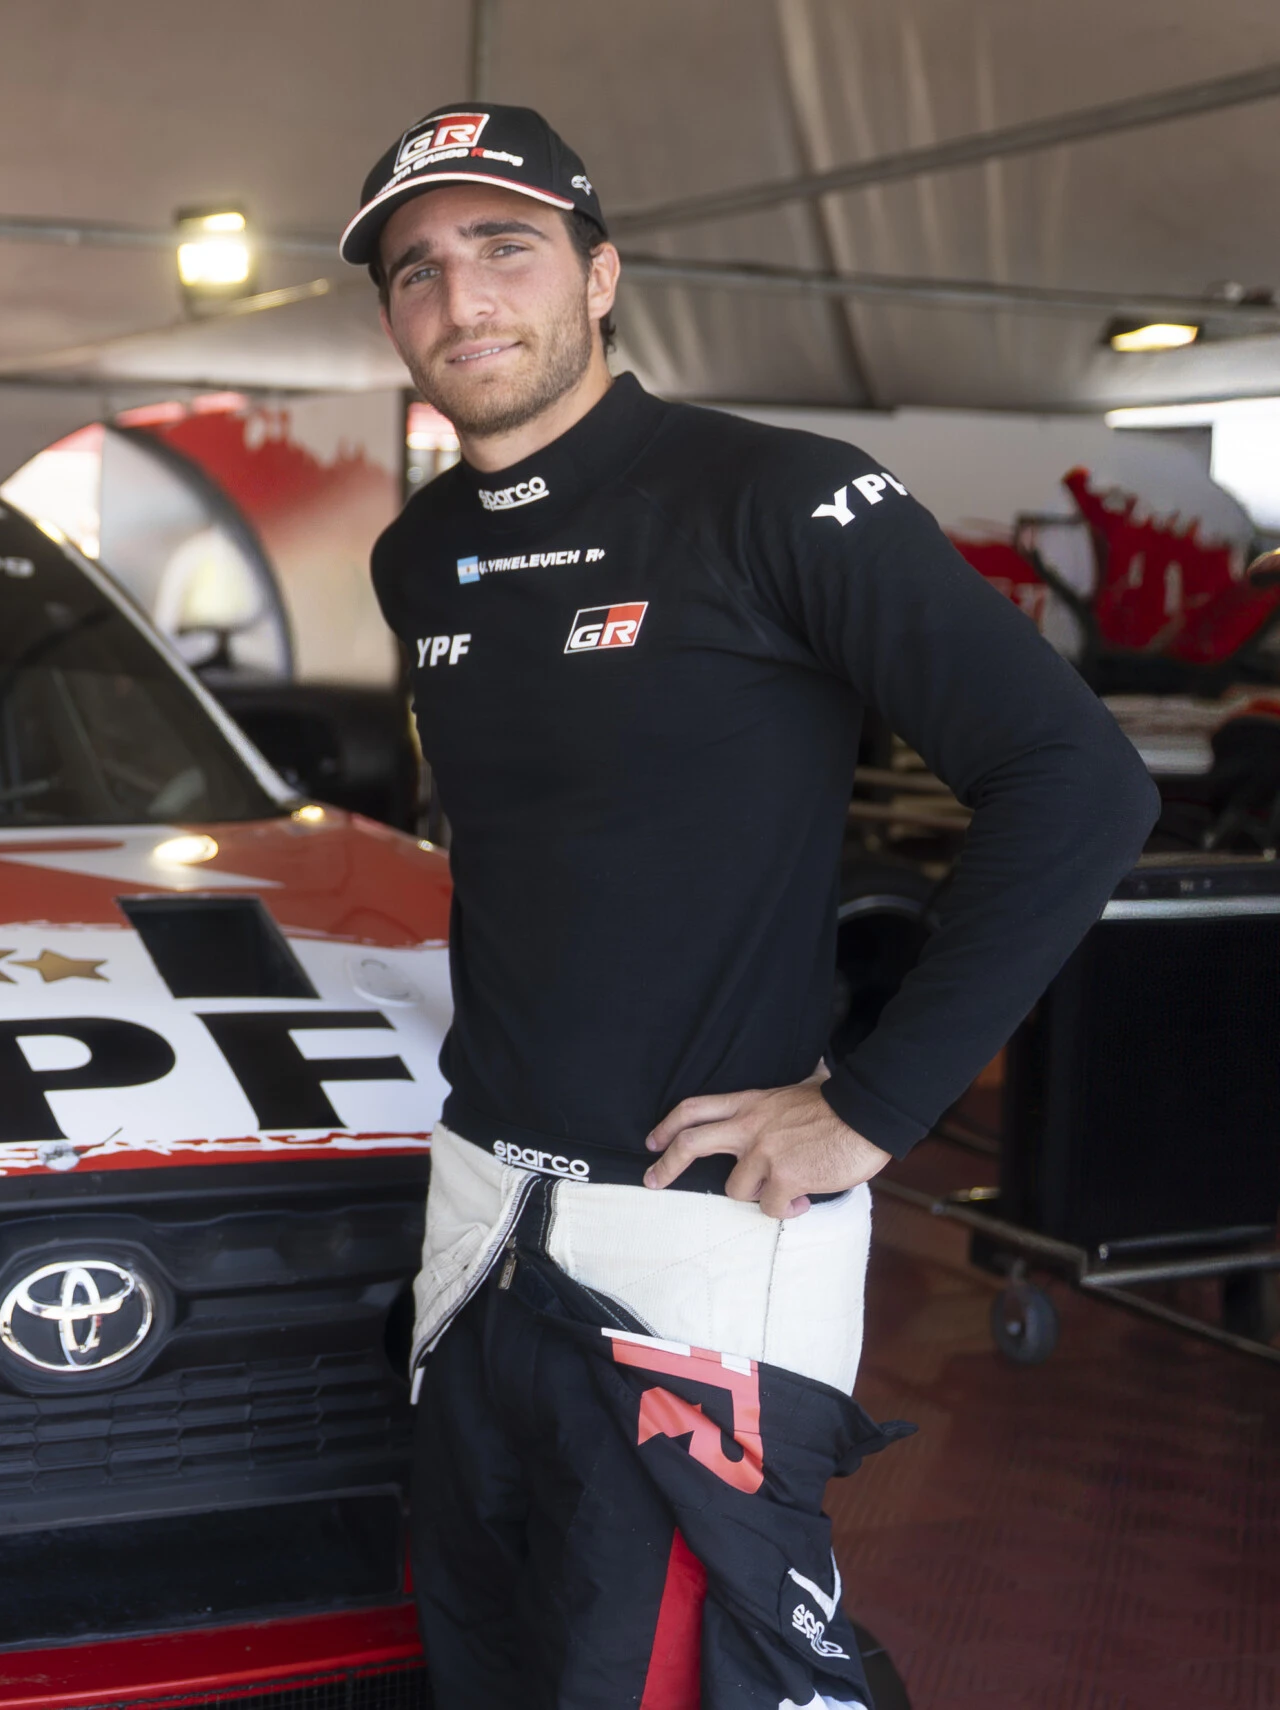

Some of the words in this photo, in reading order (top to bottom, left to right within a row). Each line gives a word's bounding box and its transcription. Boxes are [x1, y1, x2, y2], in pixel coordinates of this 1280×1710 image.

[399, 123, 478, 164] GR
[478, 476, 548, 511] sparco
[416, 633, 472, 668] YPF
[569, 618, 638, 649] GR
[493, 1139, 590, 1178] sparco
